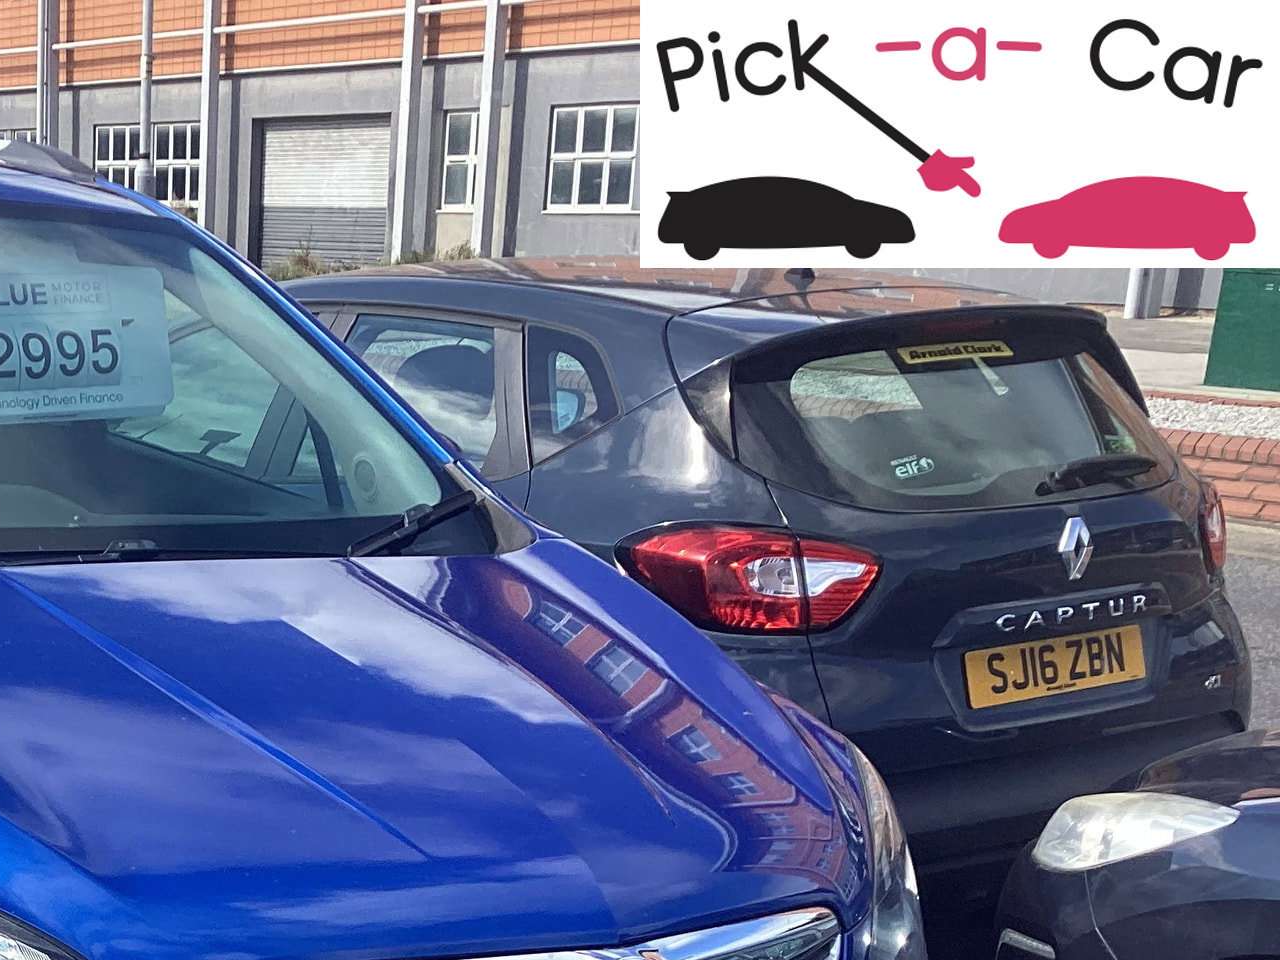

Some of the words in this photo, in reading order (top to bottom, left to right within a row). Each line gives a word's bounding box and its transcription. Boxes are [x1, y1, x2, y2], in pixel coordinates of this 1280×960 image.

[51, 282, 103, 293] MOTOR
[52, 293, 104, 306] FINANCE
[908, 346, 962, 360] Arnold
[962, 343, 1005, 354] Clark
[42, 393, 78, 408] Driven
[78, 392, 125, 405] Finance
[994, 594, 1148, 632] CAPTUR
[986, 643, 1059, 694] SJ16
[1068, 632, 1127, 684] ZBN
